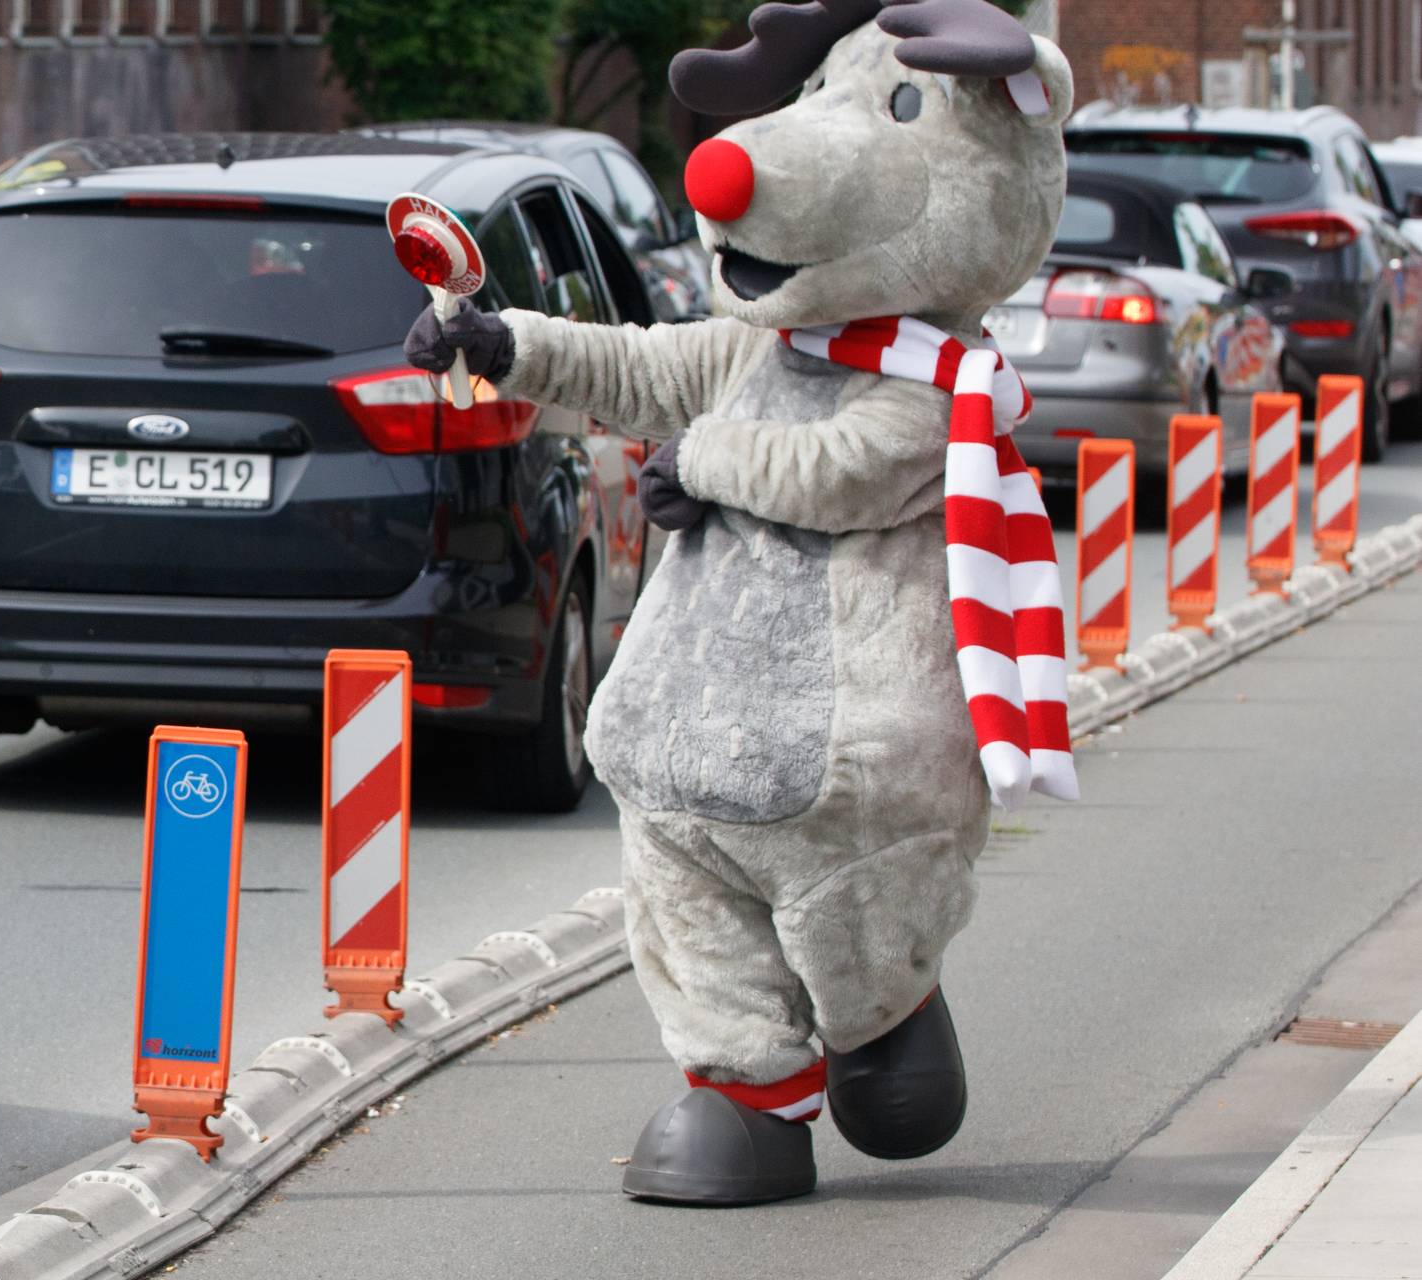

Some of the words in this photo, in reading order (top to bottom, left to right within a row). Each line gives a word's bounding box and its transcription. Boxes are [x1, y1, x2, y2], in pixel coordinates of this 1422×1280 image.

[409, 197, 454, 227] HALT
[88, 454, 109, 488] E
[135, 455, 179, 490] CL
[189, 457, 254, 492] 519
[162, 1043, 218, 1059] horizont
